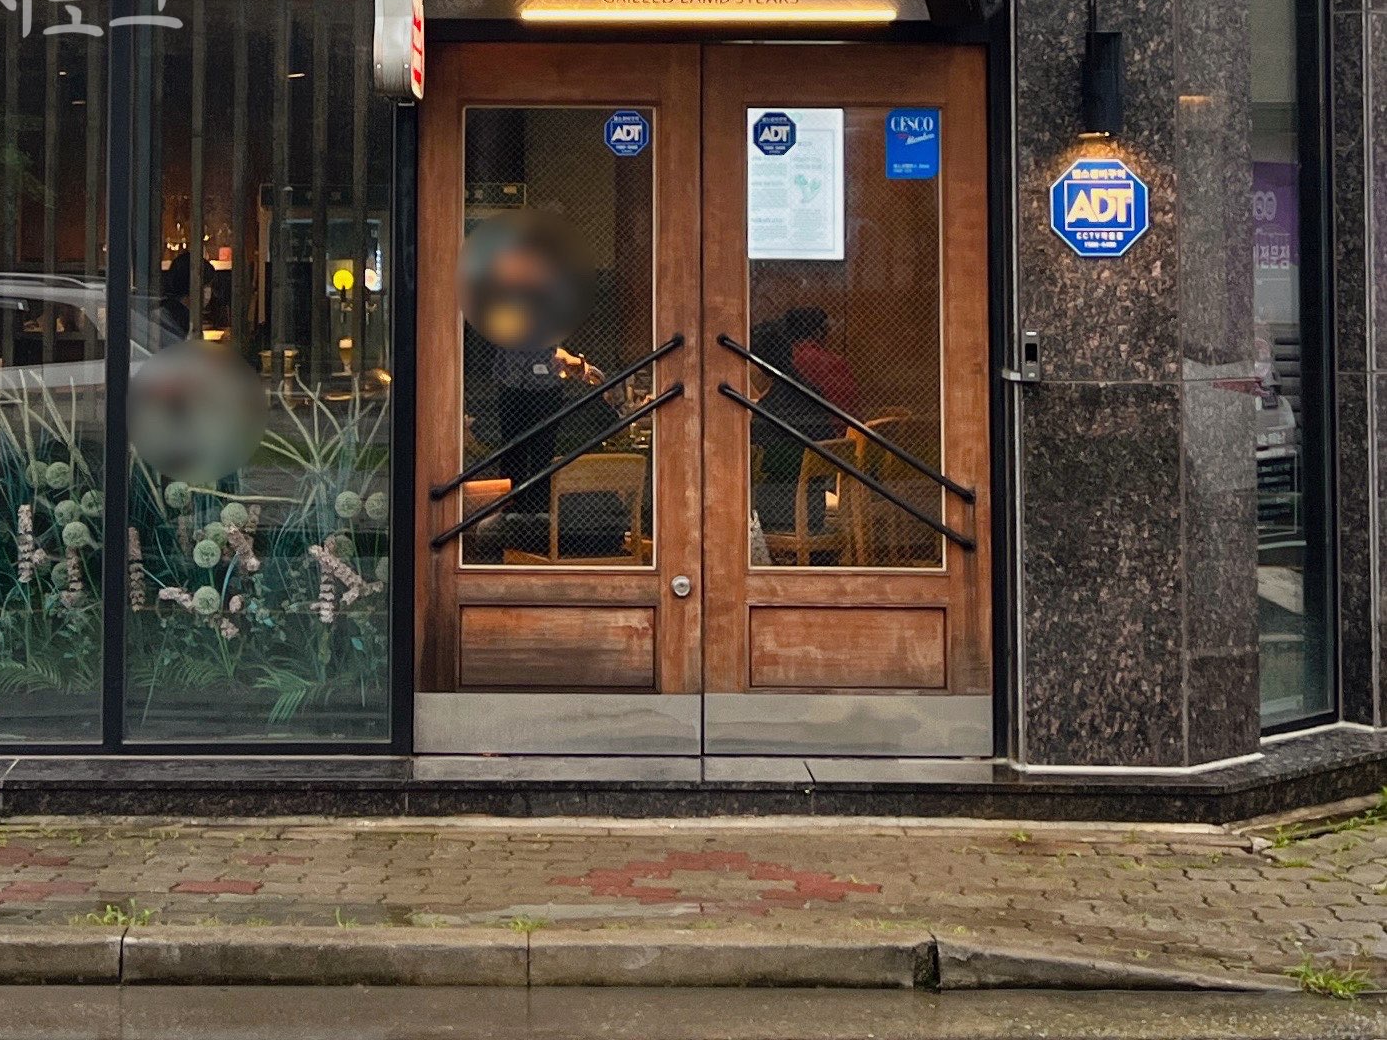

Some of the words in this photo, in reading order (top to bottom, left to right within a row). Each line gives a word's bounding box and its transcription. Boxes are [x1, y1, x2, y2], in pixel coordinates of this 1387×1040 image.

[890, 116, 934, 132] CESCO
[611, 124, 643, 142] ADT
[758, 125, 791, 142] ADT
[1066, 187, 1133, 224] ADT
